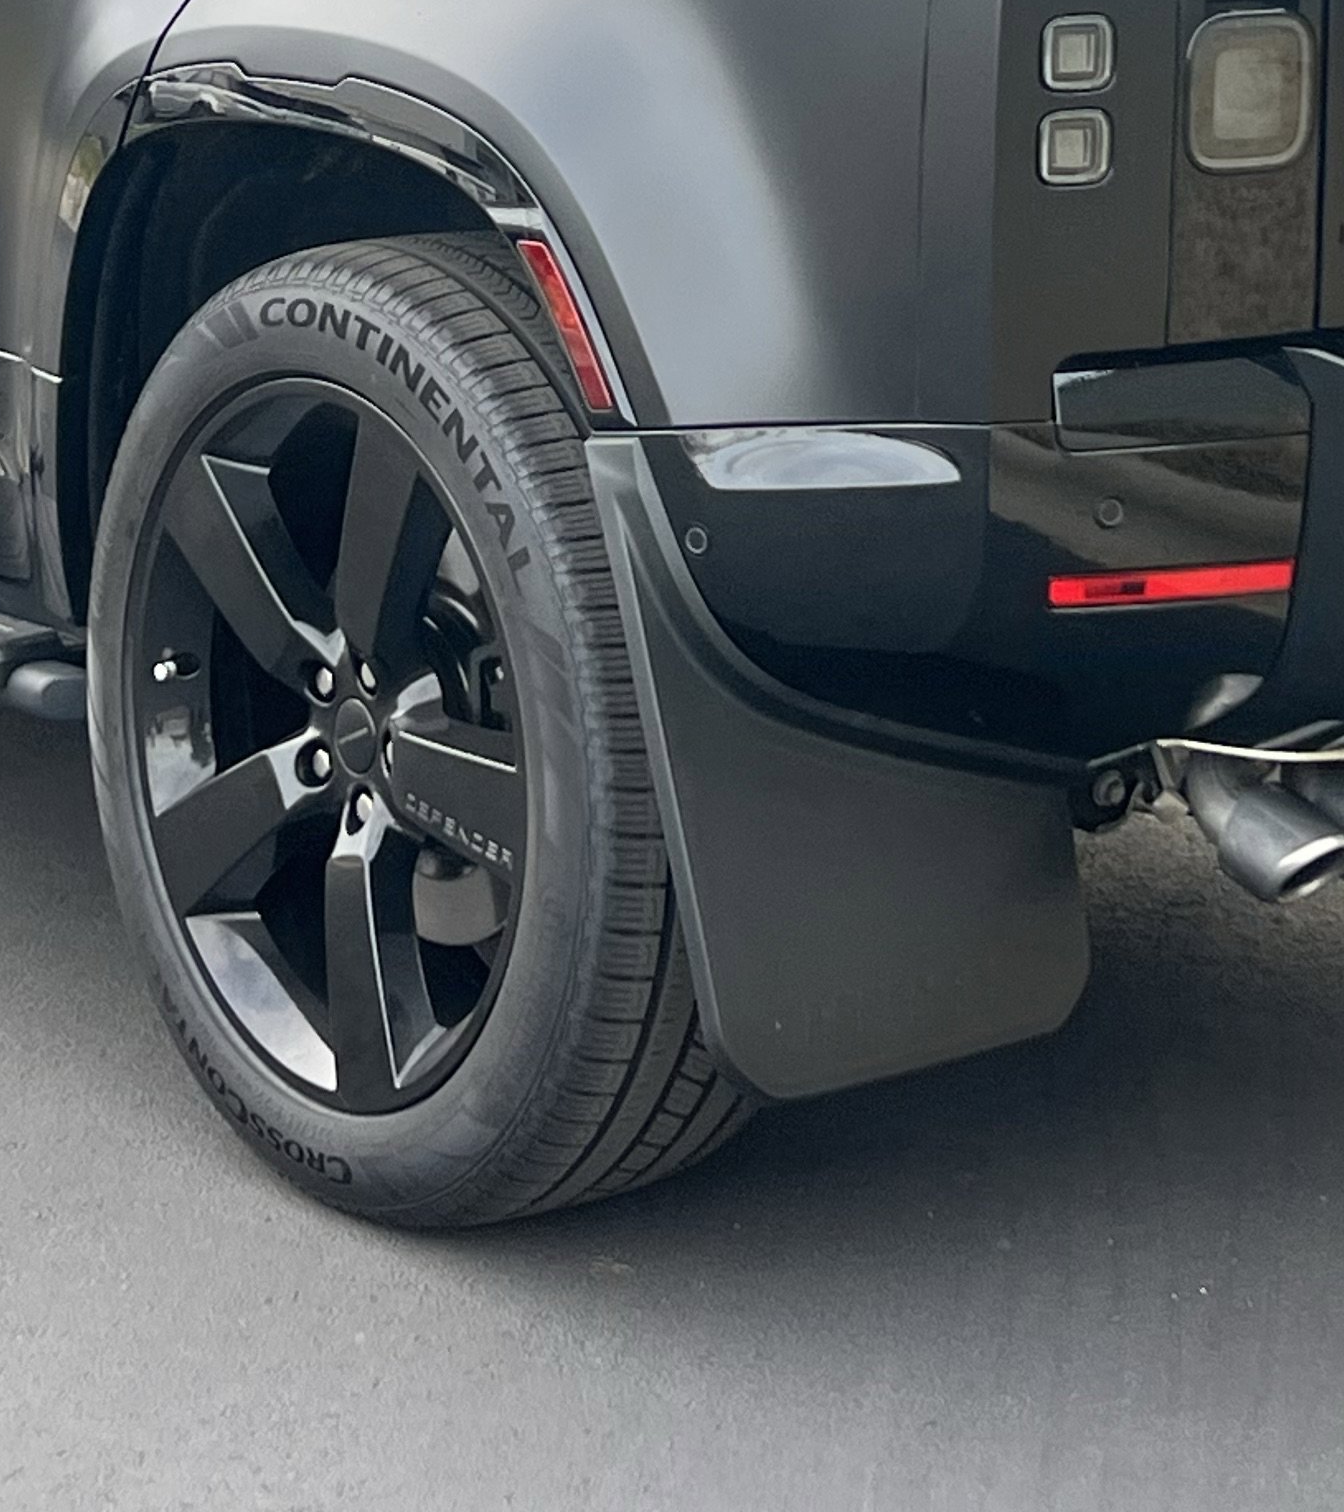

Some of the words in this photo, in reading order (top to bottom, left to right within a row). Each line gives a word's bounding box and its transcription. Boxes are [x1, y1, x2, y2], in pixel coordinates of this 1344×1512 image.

[259, 296, 532, 595] CONTINENTAL
[404, 792, 513, 872] DEFENDER
[140, 934, 353, 1186] CROSSCONTA
